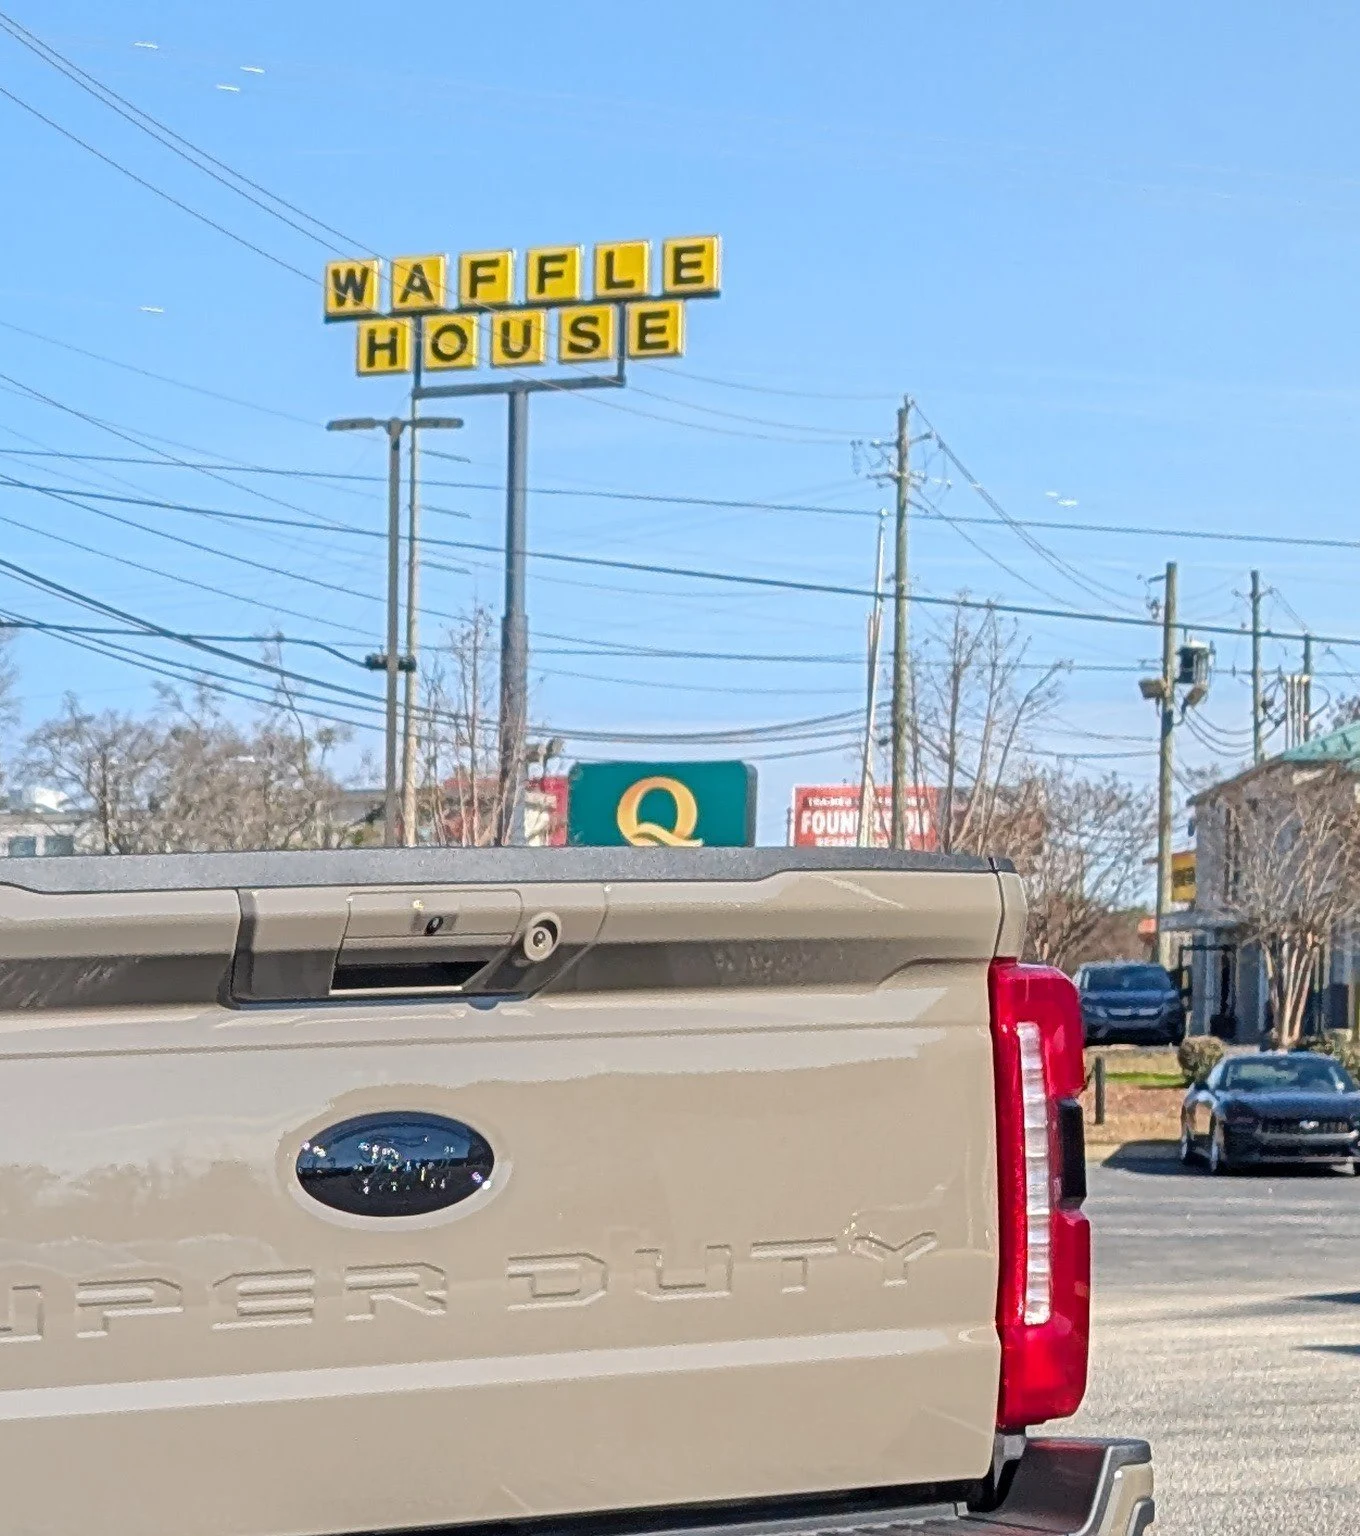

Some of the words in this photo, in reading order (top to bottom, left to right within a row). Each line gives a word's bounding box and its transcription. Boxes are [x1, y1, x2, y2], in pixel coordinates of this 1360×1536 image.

[331, 244, 707, 307] WAFFLE
[366, 309, 670, 368] HOUSE
[617, 776, 705, 847] Q
[507, 1232, 937, 1313] DUTY
